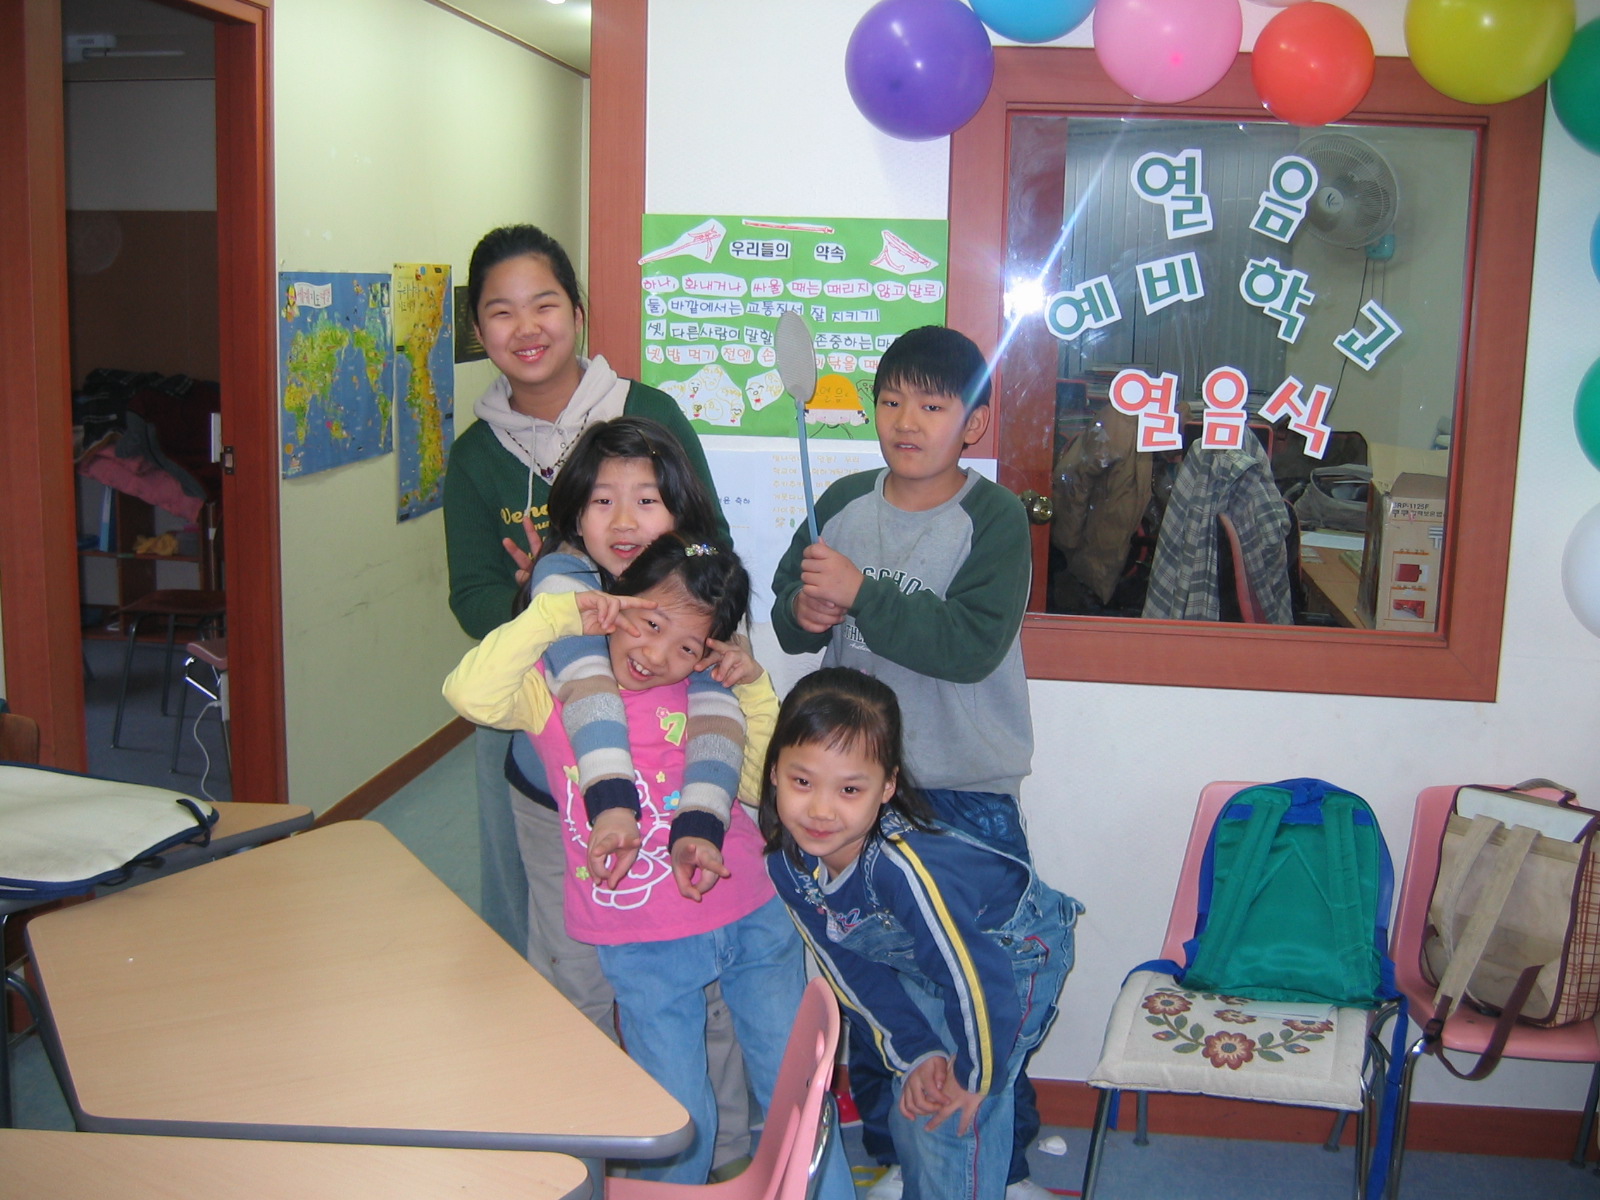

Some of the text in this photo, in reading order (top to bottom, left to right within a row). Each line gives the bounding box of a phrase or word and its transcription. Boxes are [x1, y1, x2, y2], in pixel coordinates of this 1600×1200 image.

[731, 241, 845, 261] 우리들의 약속
[643, 276, 676, 290] 하나,
[685, 277, 742, 292] 화내거나
[753, 278, 781, 294] 싸울
[792, 281, 820, 295] 때는
[827, 282, 870, 295] 때리지
[876, 283, 905, 299] 않고
[647, 298, 665, 314] 둘,
[671, 299, 742, 316] 바깥에서는
[811, 306, 825, 321] 잘
[1047, 255, 1399, 368] 예비학교
[672, 325, 699, 340] 다른
[700, 326, 740, 341] 사람이
[745, 328, 773, 345] 말할
[815, 333, 872, 350] 존중하는
[688, 349, 715, 361] 먹기
[723, 347, 751, 362] 전엔
[761, 348, 775, 362] 손
[828, 355, 856, 371] 닦을
[1112, 369, 1332, 456] 열음식
[659, 711, 688, 746] 7
